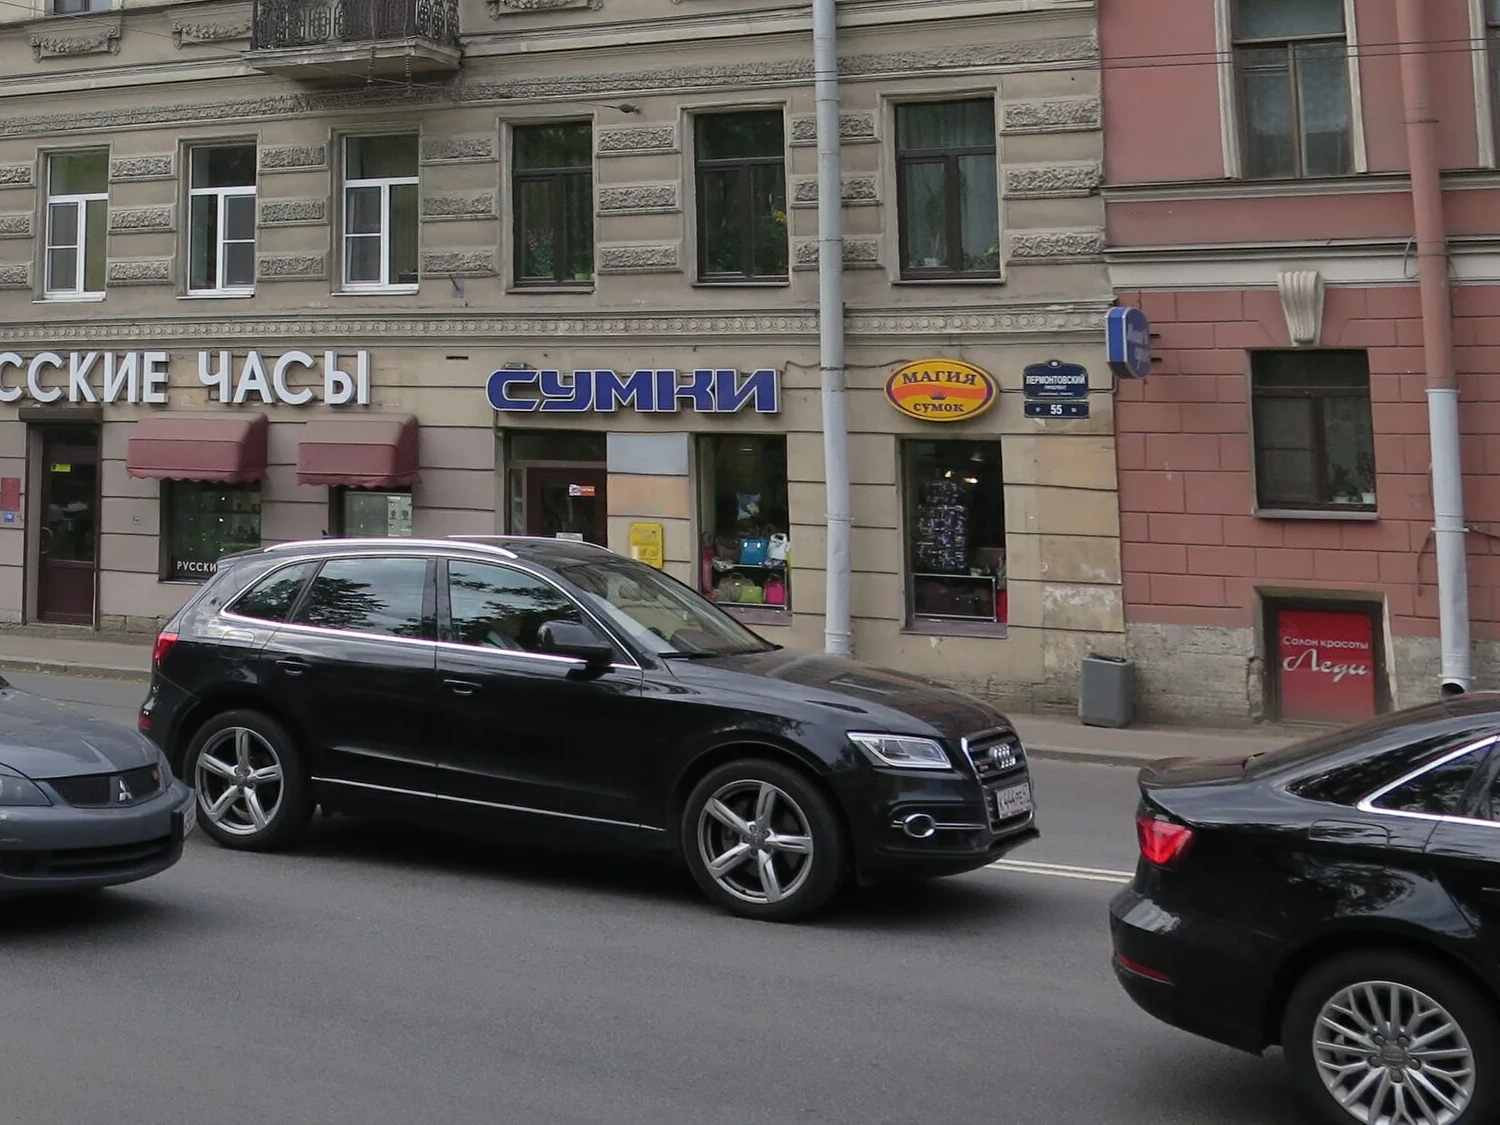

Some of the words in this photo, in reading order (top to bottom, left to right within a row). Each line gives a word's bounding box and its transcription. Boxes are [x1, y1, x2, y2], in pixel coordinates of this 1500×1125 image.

[198, 350, 371, 406] ЧАСЫ
[902, 370, 978, 386] МАГИЯ
[486, 369, 781, 413] СУМКИ
[1049, 404, 1063, 415] 55
[176, 560, 217, 573] РУССКИ
[1282, 636, 1318, 647] Салон
[1320, 639, 1369, 650] красоты
[1282, 648, 1367, 683] Леди
